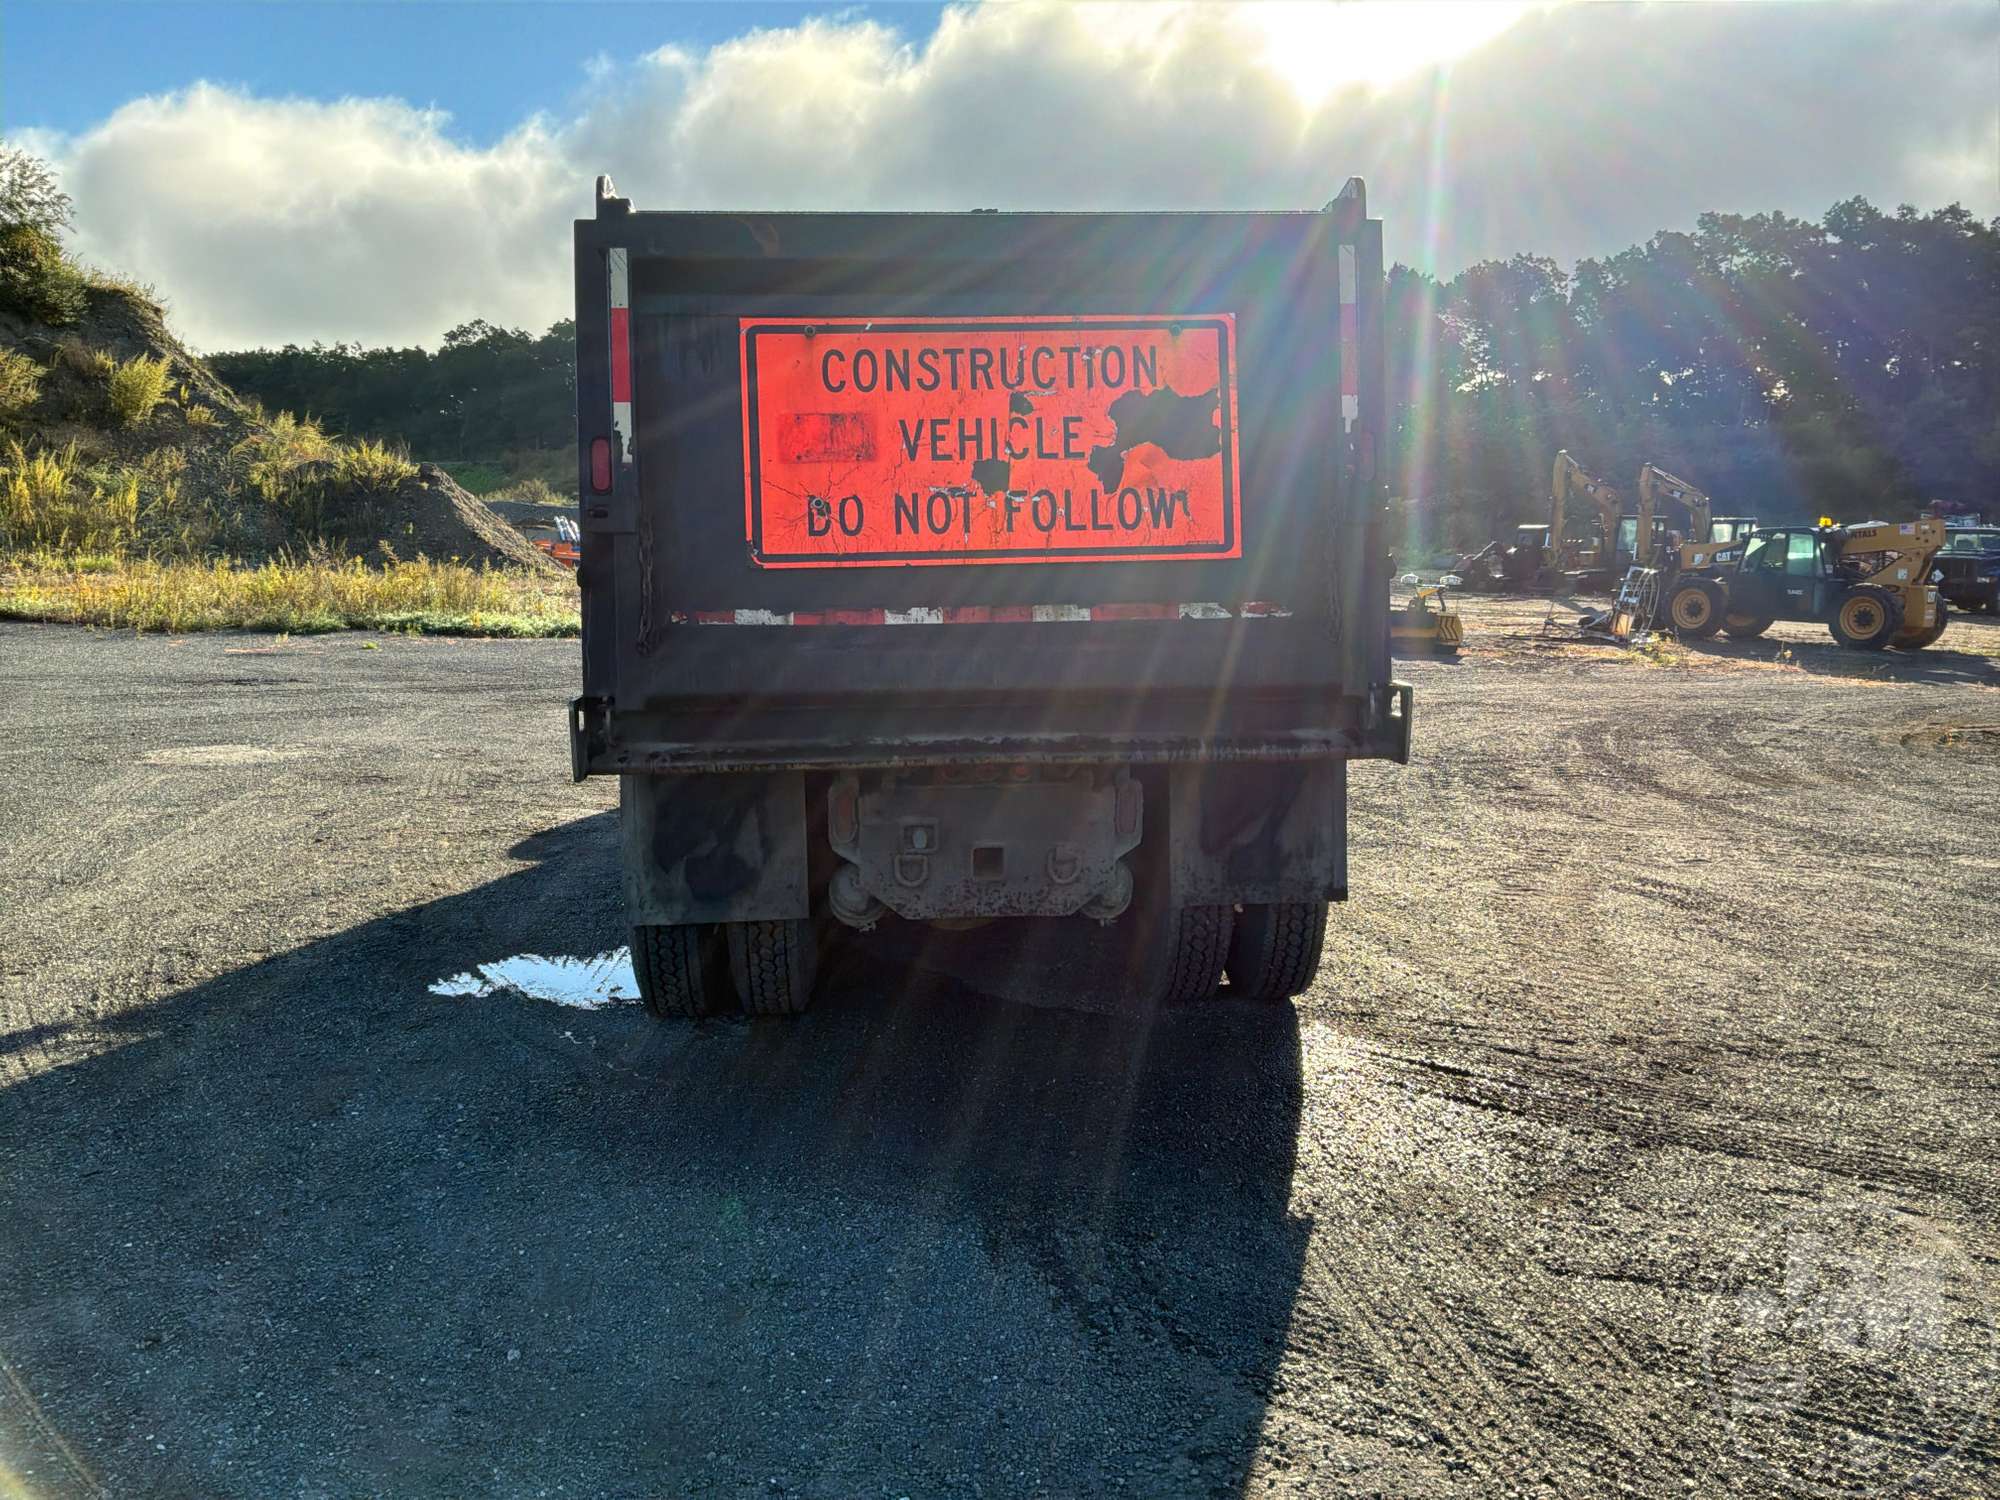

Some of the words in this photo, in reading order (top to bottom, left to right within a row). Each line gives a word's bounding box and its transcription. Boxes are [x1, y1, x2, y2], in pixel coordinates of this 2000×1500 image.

[821, 345, 1157, 392] CONSTRUCTION
[899, 416, 1086, 461] VEHICLE
[808, 494, 864, 536] DO
[895, 491, 977, 535] NOT
[1006, 487, 1176, 533] FOLLOW
[1716, 551, 1731, 562] CAT
